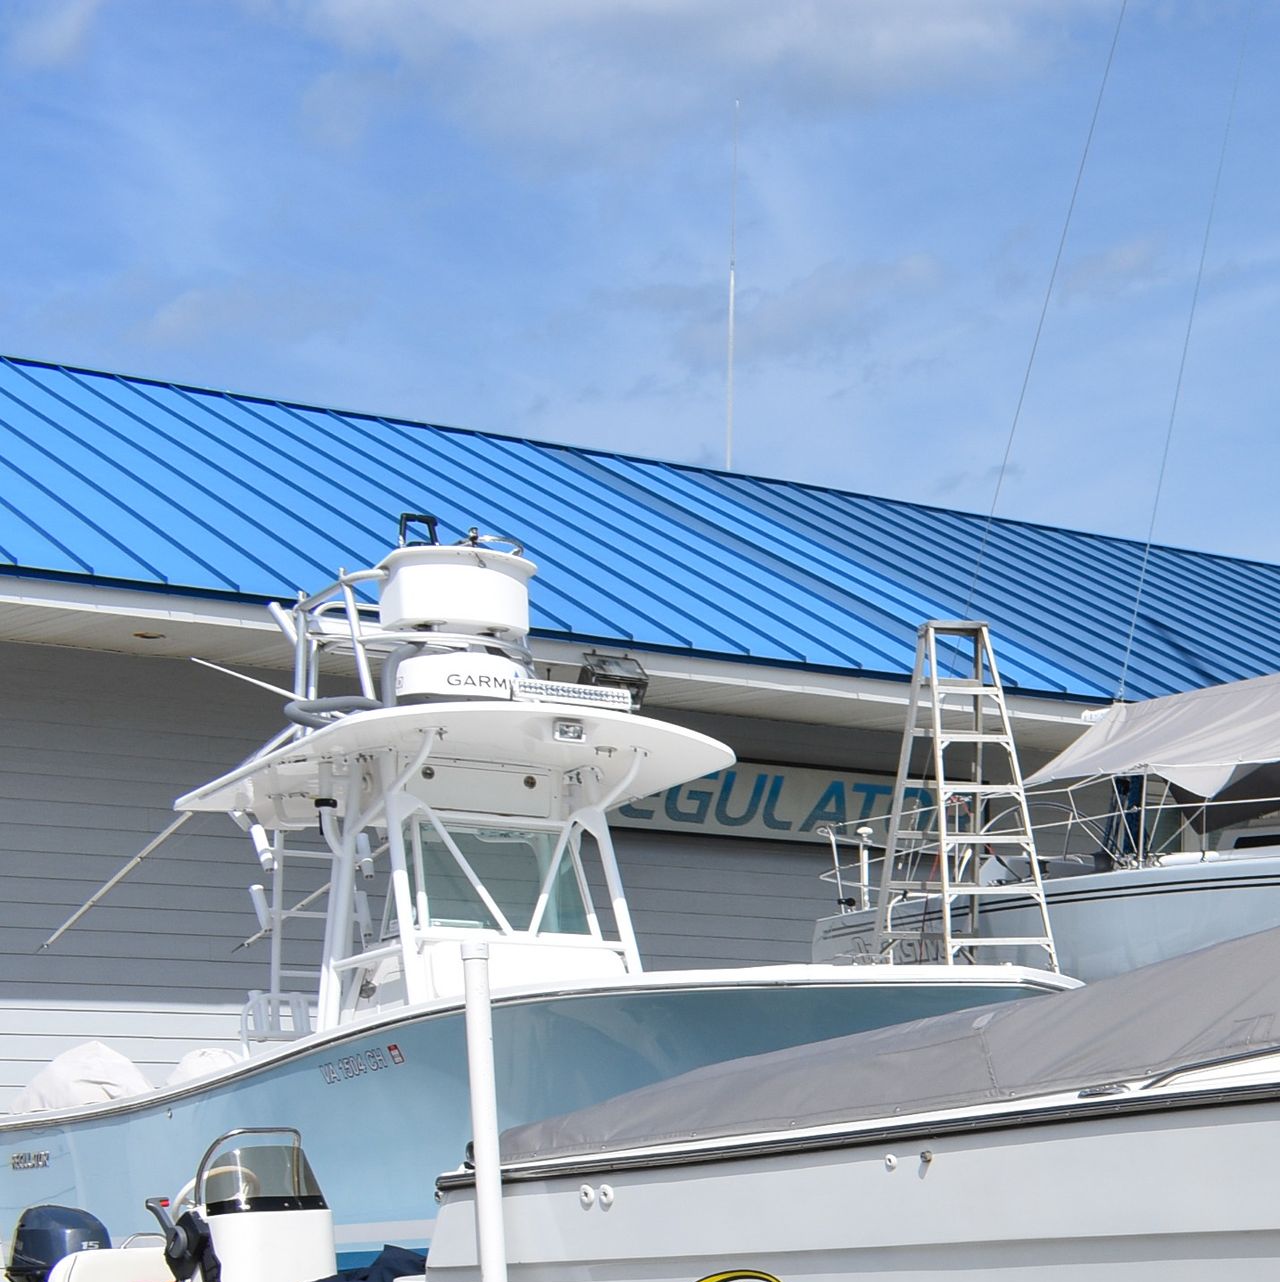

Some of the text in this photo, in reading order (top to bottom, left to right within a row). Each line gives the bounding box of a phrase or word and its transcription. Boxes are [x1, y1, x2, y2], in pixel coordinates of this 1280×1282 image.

[338, 1053, 368, 1080] 1504
[365, 1047, 388, 1071] CH
[81, 1241, 100, 1250] 15
